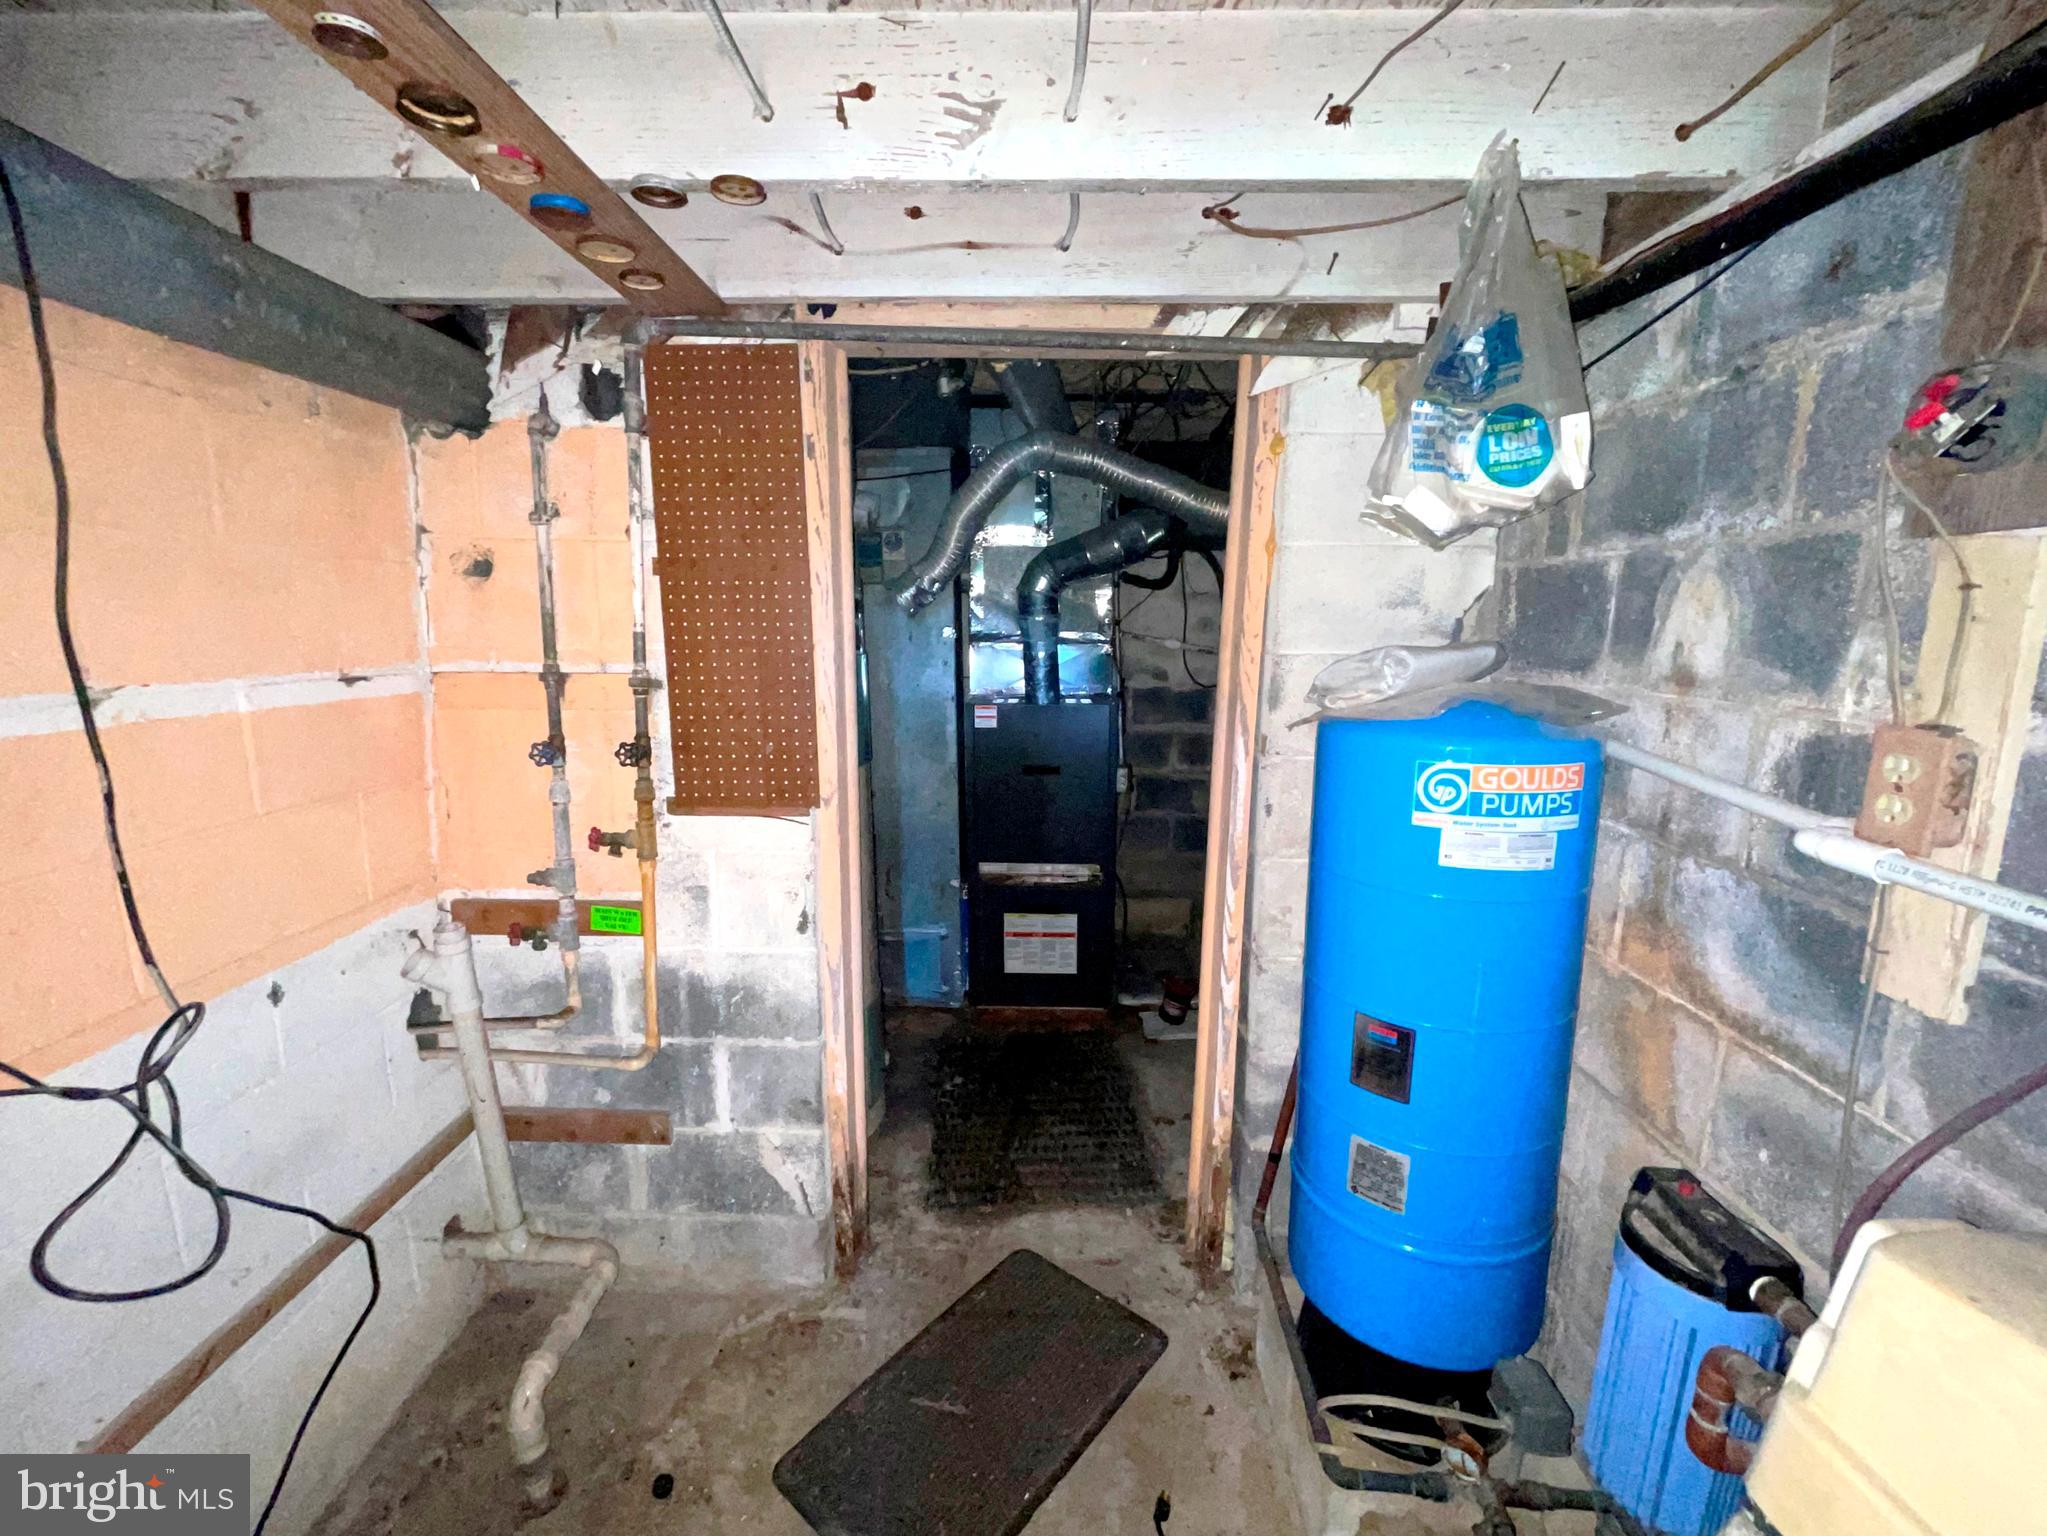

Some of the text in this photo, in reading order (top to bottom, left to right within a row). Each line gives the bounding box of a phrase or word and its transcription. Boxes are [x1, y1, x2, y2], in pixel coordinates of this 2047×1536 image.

[1488, 427, 1538, 451] LOW
[1489, 445, 1543, 464] PRICES
[1478, 766, 1579, 789] GOULDS
[1481, 793, 1573, 816] PUMPS
